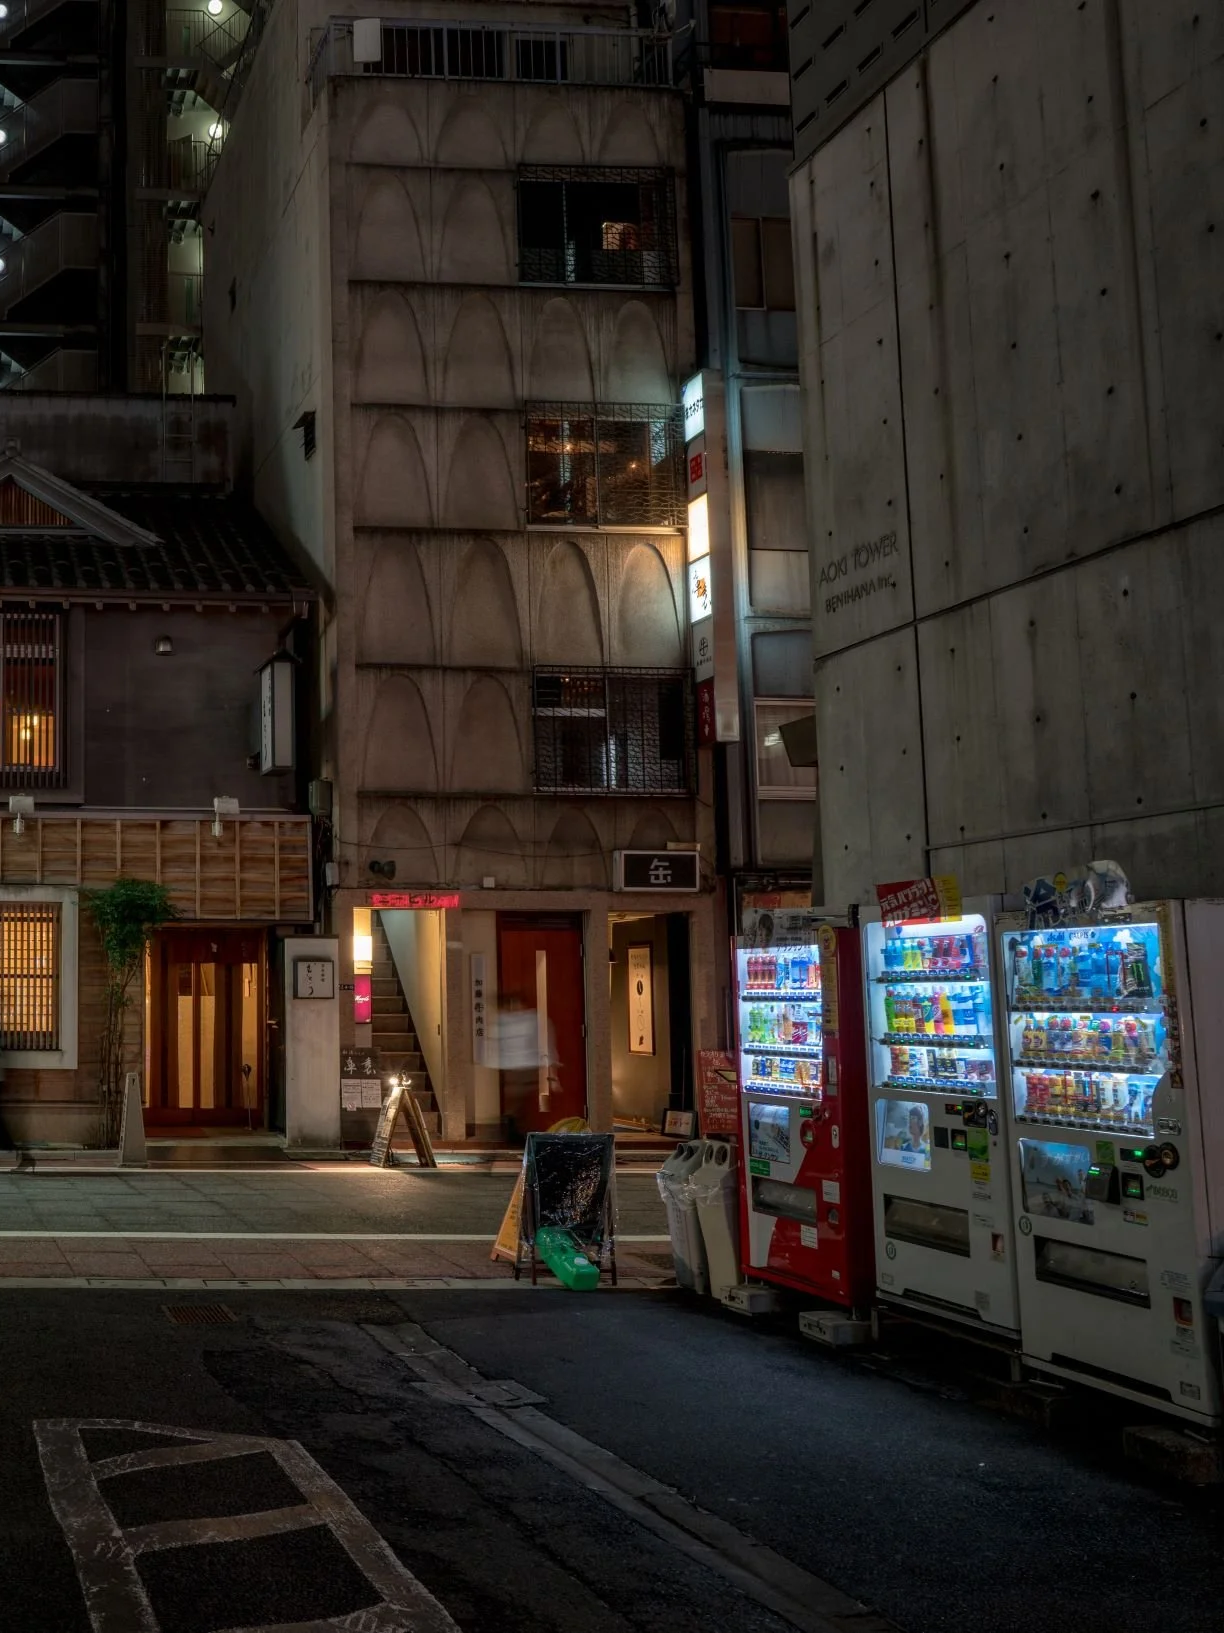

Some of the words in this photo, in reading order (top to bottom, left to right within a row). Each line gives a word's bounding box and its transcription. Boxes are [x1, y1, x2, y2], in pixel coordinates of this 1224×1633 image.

[819, 556, 848, 587] AOKI
[853, 532, 899, 571] TOWER
[825, 580, 876, 613] BENIHANA
